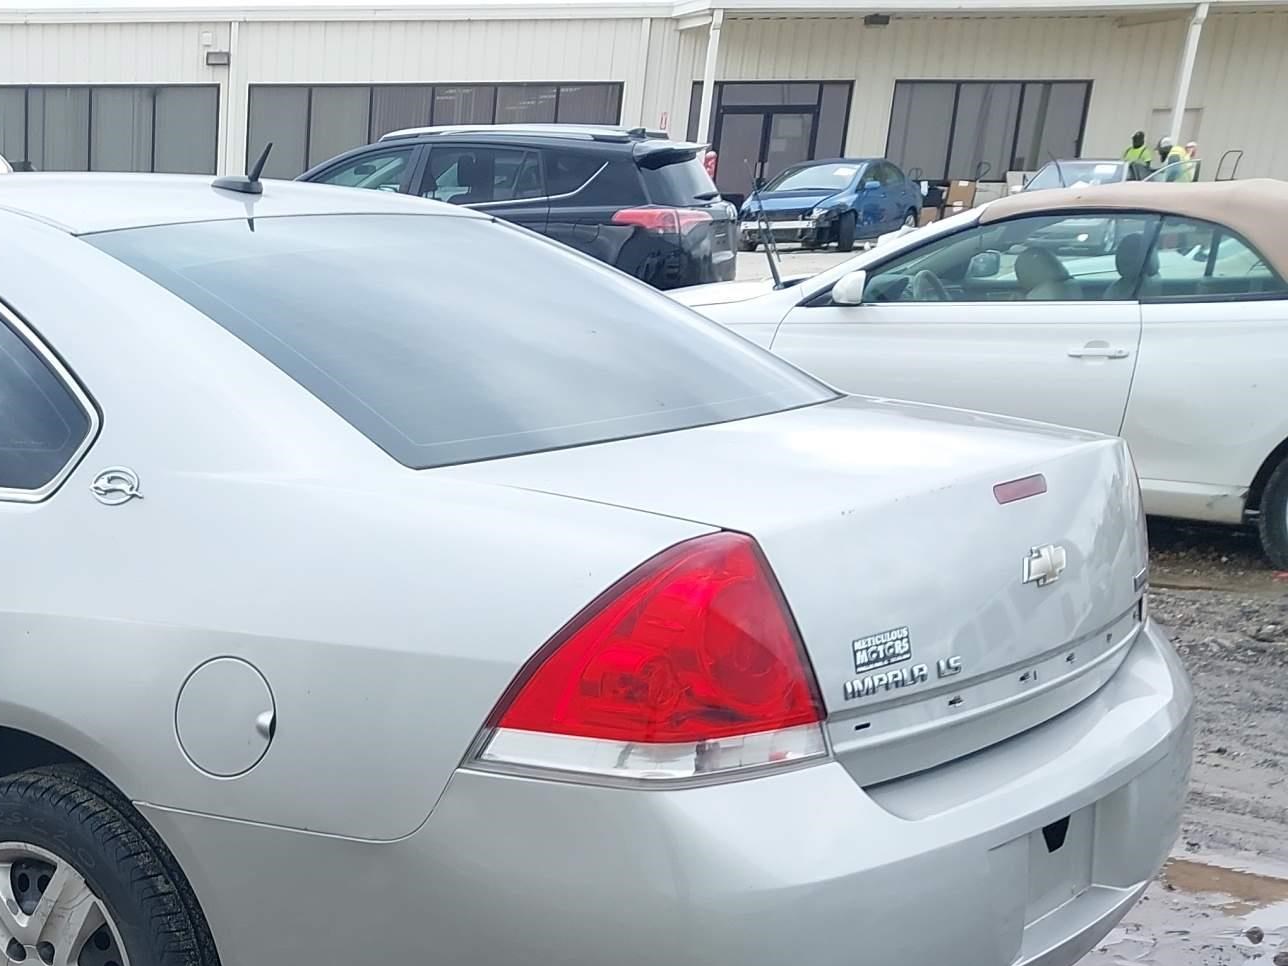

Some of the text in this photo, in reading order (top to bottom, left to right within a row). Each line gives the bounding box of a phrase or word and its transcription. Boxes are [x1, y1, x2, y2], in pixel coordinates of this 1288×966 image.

[854, 628, 908, 650] METICULOUS
[855, 638, 909, 665] MOTORS
[844, 663, 928, 701] IMPALA
[936, 655, 962, 679] LS
